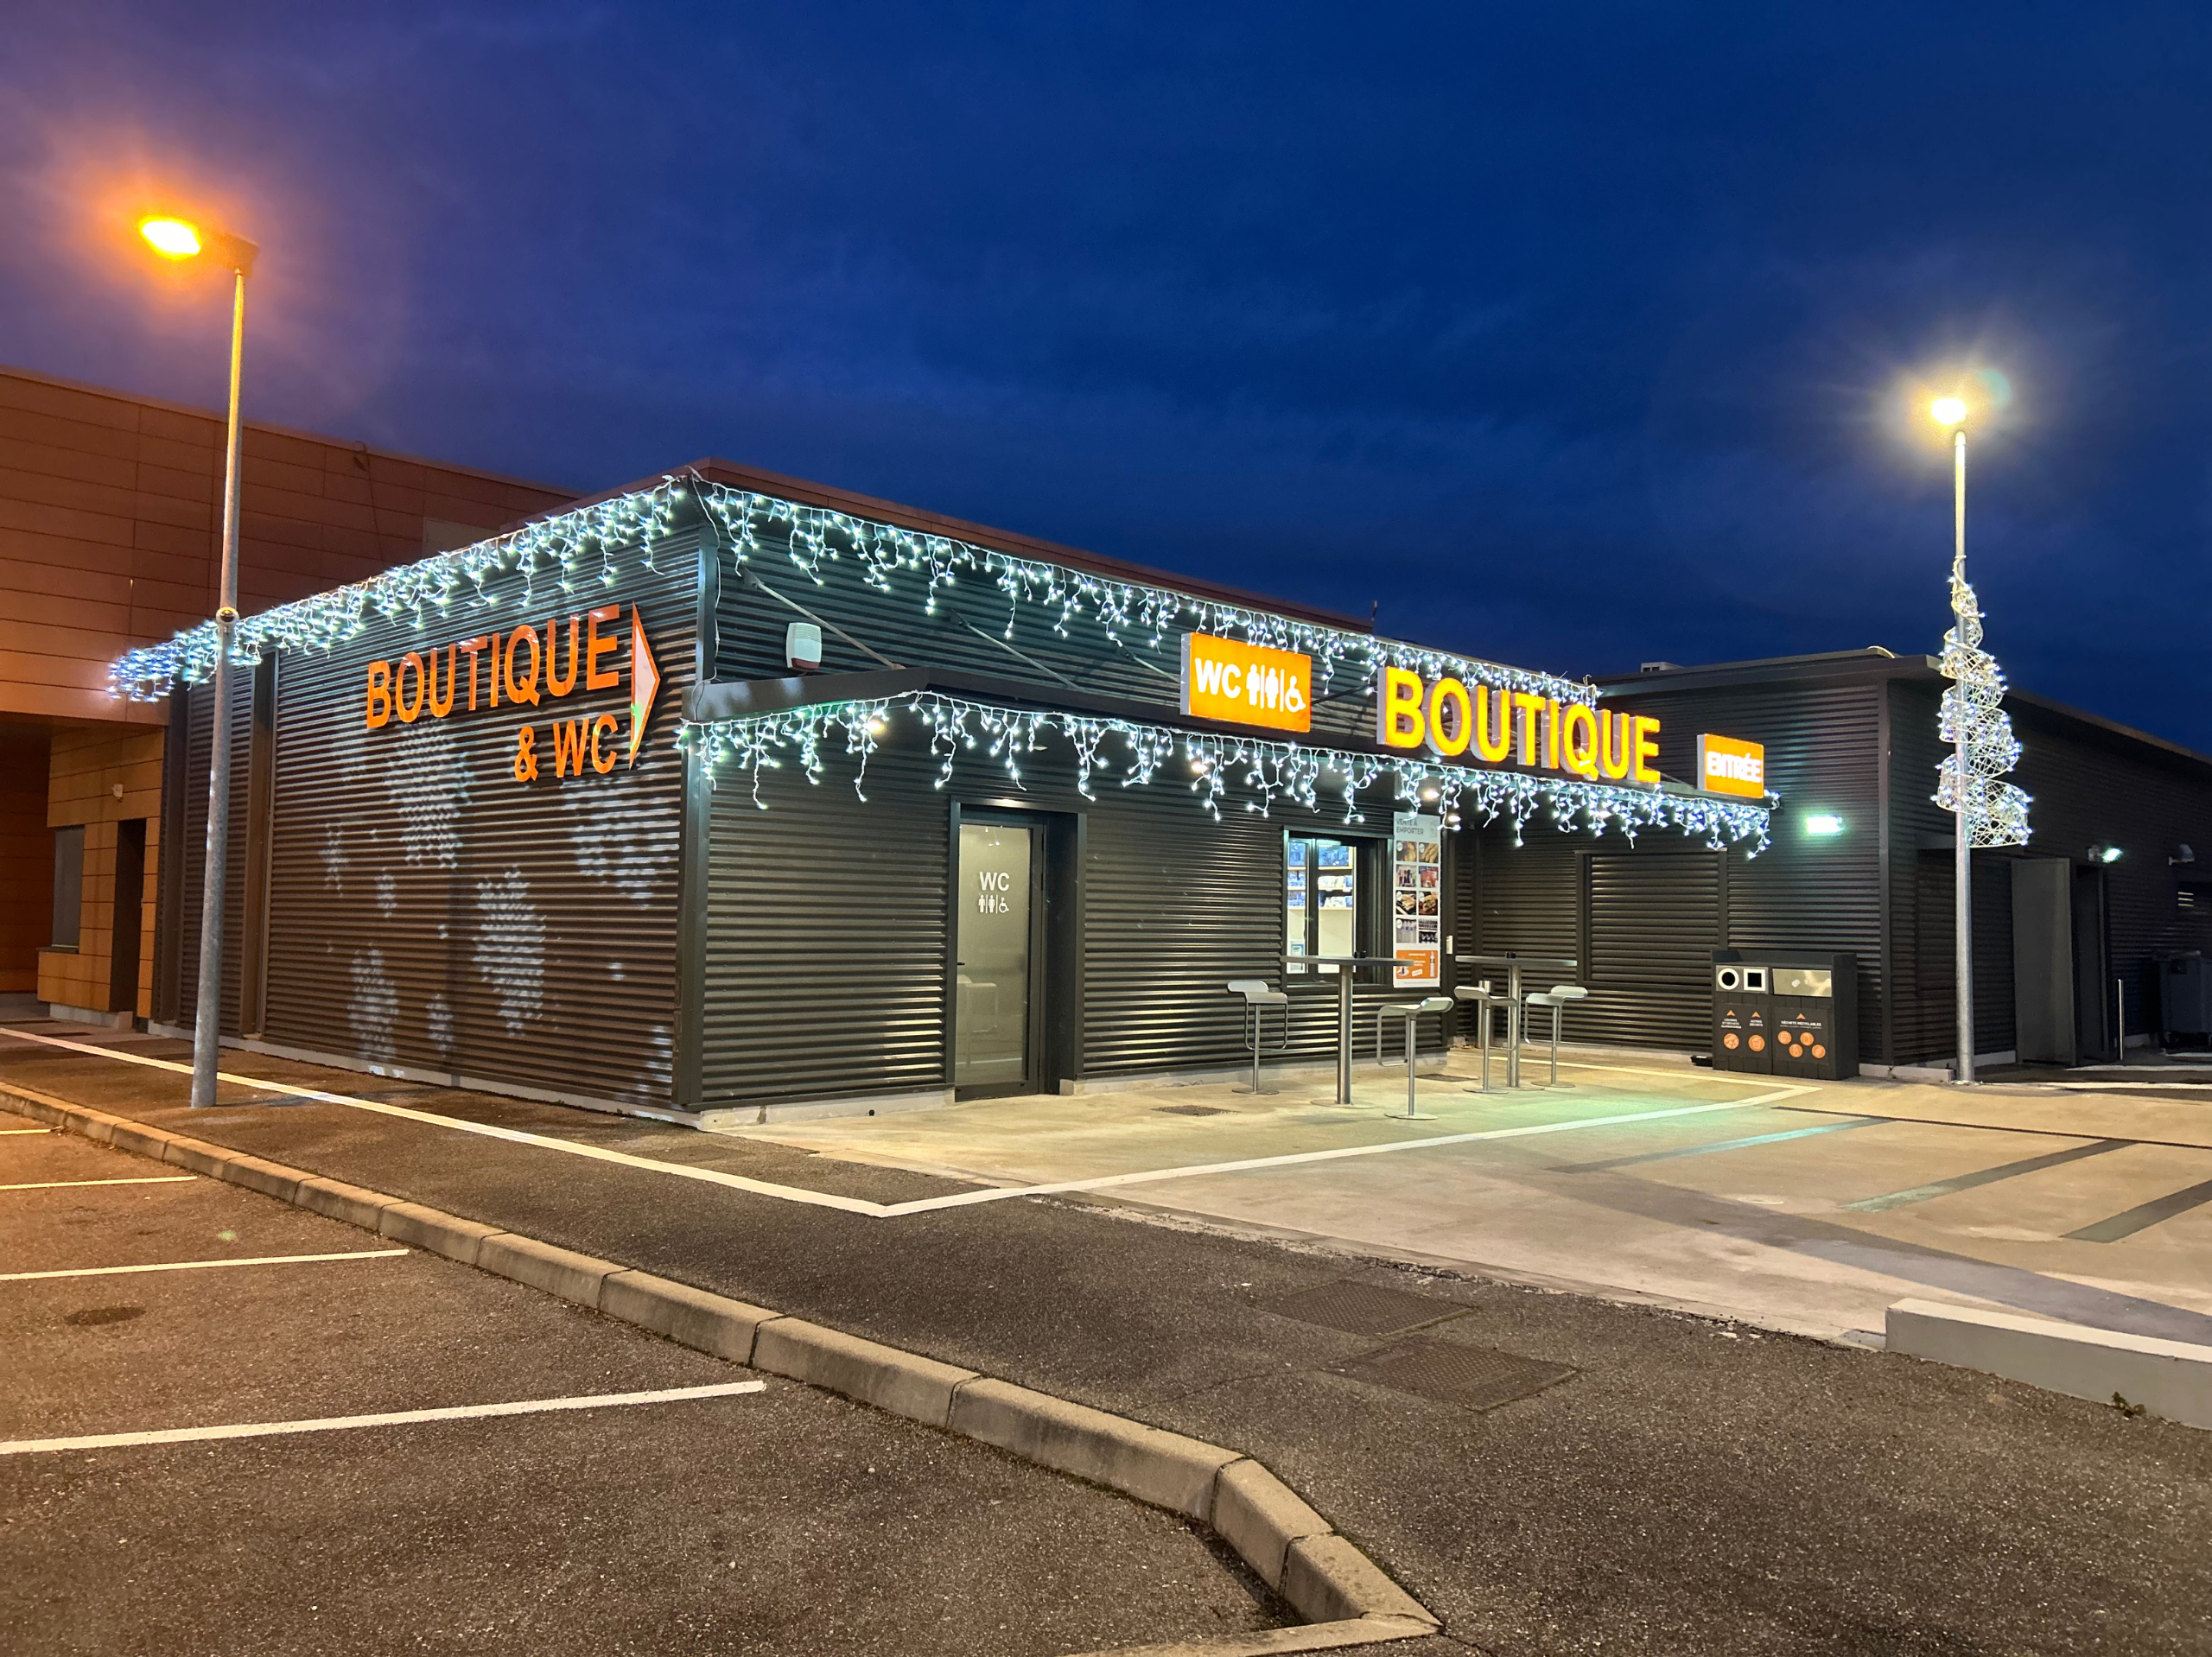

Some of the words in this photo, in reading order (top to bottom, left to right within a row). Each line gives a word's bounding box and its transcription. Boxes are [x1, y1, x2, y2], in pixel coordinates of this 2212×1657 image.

[366, 604, 620, 729] BOUTIQUE
[1194, 657, 1242, 698] WC
[1384, 666, 1661, 783] BOUTIQUE
[514, 726, 538, 782] &
[553, 714, 618, 778] WC
[1707, 751, 1762, 784] ENTRÉE
[1396, 826, 1424, 835] EMPORTER
[979, 871, 1009, 891] WC
